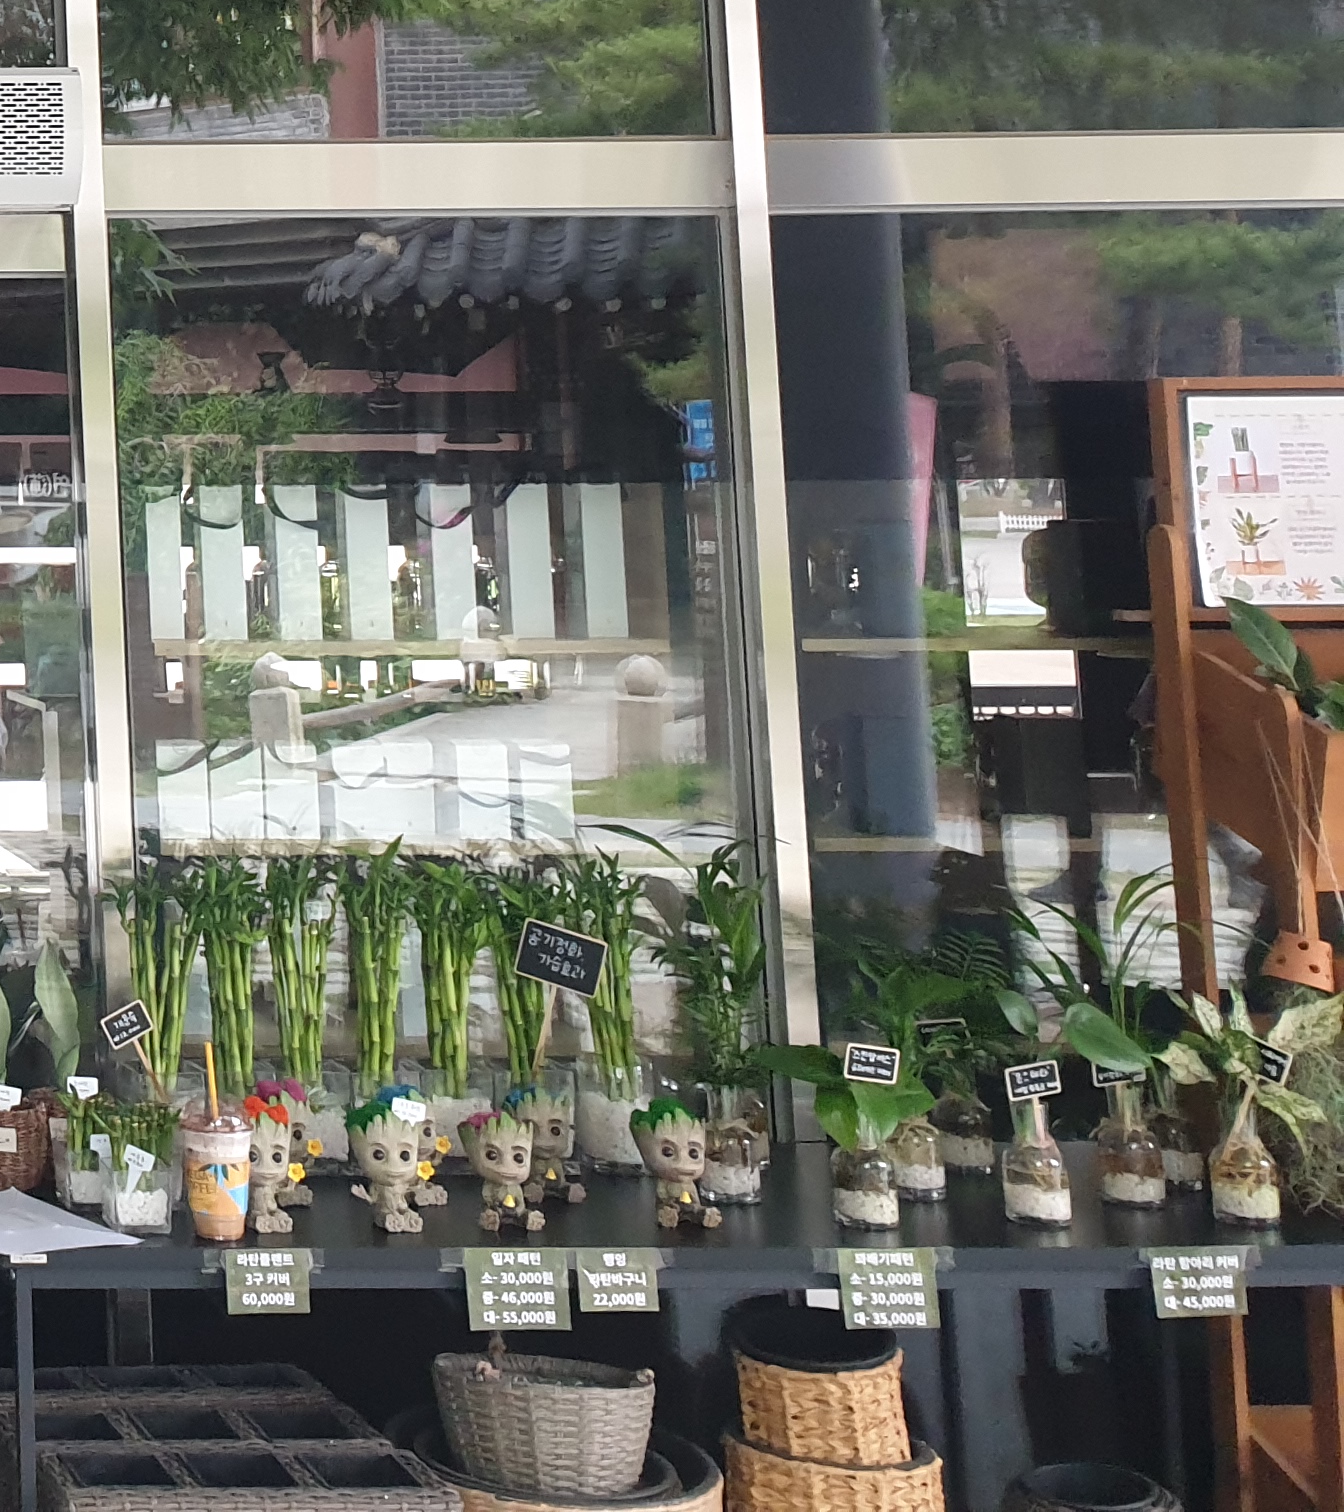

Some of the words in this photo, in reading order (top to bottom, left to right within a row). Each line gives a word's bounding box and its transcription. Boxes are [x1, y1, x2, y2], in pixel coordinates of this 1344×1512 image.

[538, 952, 586, 979] 가습효과
[491, 1252, 514, 1266] 일자
[517, 1252, 541, 1265] 패턴
[1215, 1254, 1239, 1268] 커버
[245, 1272, 264, 1286] 3구
[266, 1272, 290, 1286] 커버
[500, 1271, 554, 1286] 30,000원
[868, 1271, 923, 1287] 15,000원
[1181, 1274, 1234, 1291] 30,000원
[242, 1292, 295, 1307] 60,000원
[501, 1291, 555, 1306] 46,000원
[593, 1293, 647, 1308] 22,000원
[870, 1291, 926, 1307] 30,000원
[1182, 1294, 1235, 1311] 45,000원
[502, 1311, 556, 1325] 55,000원
[872, 1311, 927, 1326] 35,000원
